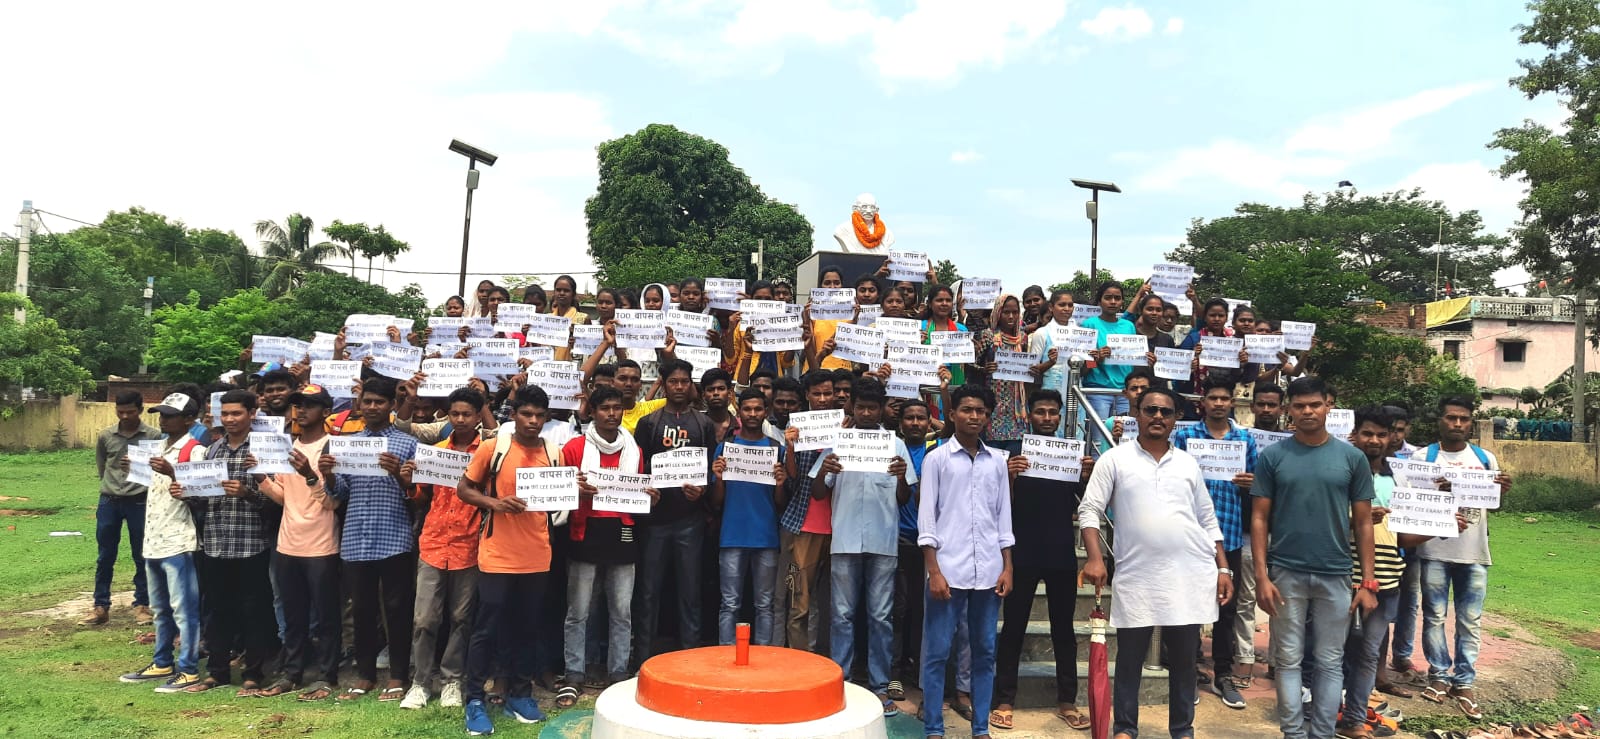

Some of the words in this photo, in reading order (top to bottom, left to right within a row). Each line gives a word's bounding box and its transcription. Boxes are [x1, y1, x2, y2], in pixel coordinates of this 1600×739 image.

[920, 252, 928, 260] लो
[735, 280, 743, 288] लो
[991, 279, 999, 287] लो
[845, 289, 853, 297] लो
[775, 301, 783, 310] लो
[635, 312, 654, 320] वापस
[656, 312, 664, 320] लो
[683, 314, 701, 322] वापस
[702, 314, 710, 323] लो
[790, 315, 800, 323] लो
[893, 320, 910, 328] वापस
[911, 319, 919, 328] लो
[837, 326, 851, 334] TOD
[854, 327, 873, 337] वापस
[875, 329, 884, 339] लो
[1090, 330, 1097, 338] लो
[485, 341, 505, 349] वापस
[507, 340, 516, 349] लो
[764, 337, 776, 345] हिन्द
[373, 342, 387, 350] TOD
[390, 344, 409, 354] वापस
[410, 348, 420, 357] लो
[908, 346, 929, 355] वापस
[931, 347, 940, 357] लो
[439, 361, 460, 370] वापस
[461, 360, 471, 369] लो
[550, 371, 570, 379] वापस
[573, 372, 582, 380] लो
[897, 368, 911, 377] हिन्द
[791, 416, 807, 424] TOD
[810, 412, 830, 422] वापस
[831, 411, 841, 420] लो
[838, 432, 854, 440] TOD
[858, 432, 880, 441] वापस
[882, 431, 892, 441] लो
[331, 440, 346, 448] TOD
[350, 440, 371, 448] वापस
[373, 439, 384, 448] लो
[1024, 438, 1041, 446] TOD
[1045, 440, 1069, 450] वापस
[1070, 441, 1081, 451] लो
[1188, 442, 1205, 450] TOD
[1209, 443, 1232, 451] वापस
[1233, 443, 1243, 452] लो
[418, 447, 432, 456] TOD
[437, 450, 459, 461] वापस
[672, 449, 693, 459] वापस
[695, 448, 704, 457] लो
[725, 445, 740, 454] TOD
[743, 446, 764, 456] वापस
[765, 448, 775, 457] लो
[848, 455, 862, 463] हिन्द
[193, 462, 212, 470] वापस
[214, 461, 224, 469] लो
[342, 461, 356, 469] हिन्द
[1032, 461, 1047, 471] हिन्द
[1061, 466, 1079, 475] भारत
[426, 470, 440, 479] हिन्द
[517, 472, 535, 480] TOD
[539, 470, 563, 479] वापस
[566, 467, 575, 479] लो
[734, 466, 748, 475] हिन्द
[749, 468, 759, 476] जय
[598, 473, 614, 481] TOD
[618, 474, 640, 484] वापस
[641, 476, 651, 485] लो
[663, 473, 677, 482] हिन्द
[678, 473, 689, 481] जय
[530, 495, 545, 504] हिन्द
[559, 495, 576, 503] भारत
[604, 496, 619, 505] हिन्द
[1392, 491, 1412, 500] TOD
[1416, 492, 1442, 503] वापस
[1444, 493, 1455, 505] लो
[1389, 516, 1401, 524] जय
[1403, 516, 1419, 526] हिन्द
[1420, 519, 1433, 527] जय
[1435, 521, 1455, 529] भारत
